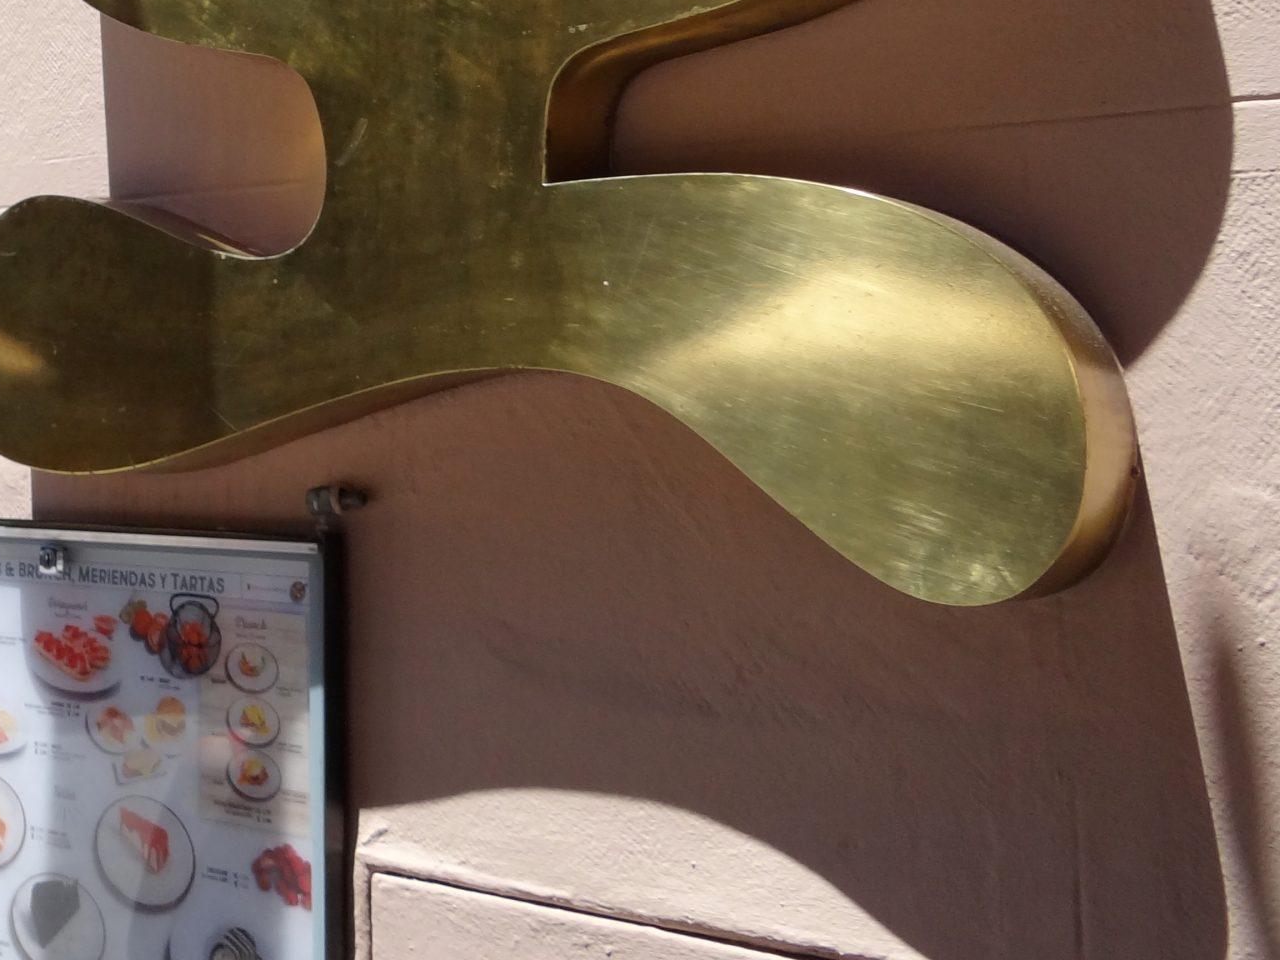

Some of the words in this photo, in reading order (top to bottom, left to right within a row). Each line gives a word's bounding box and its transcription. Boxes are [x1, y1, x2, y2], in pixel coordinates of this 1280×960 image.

[5, 562, 15, 576] &
[78, 566, 156, 589] MERIENDAS
[160, 574, 169, 589] Y
[171, 573, 225, 594] TARTAS
